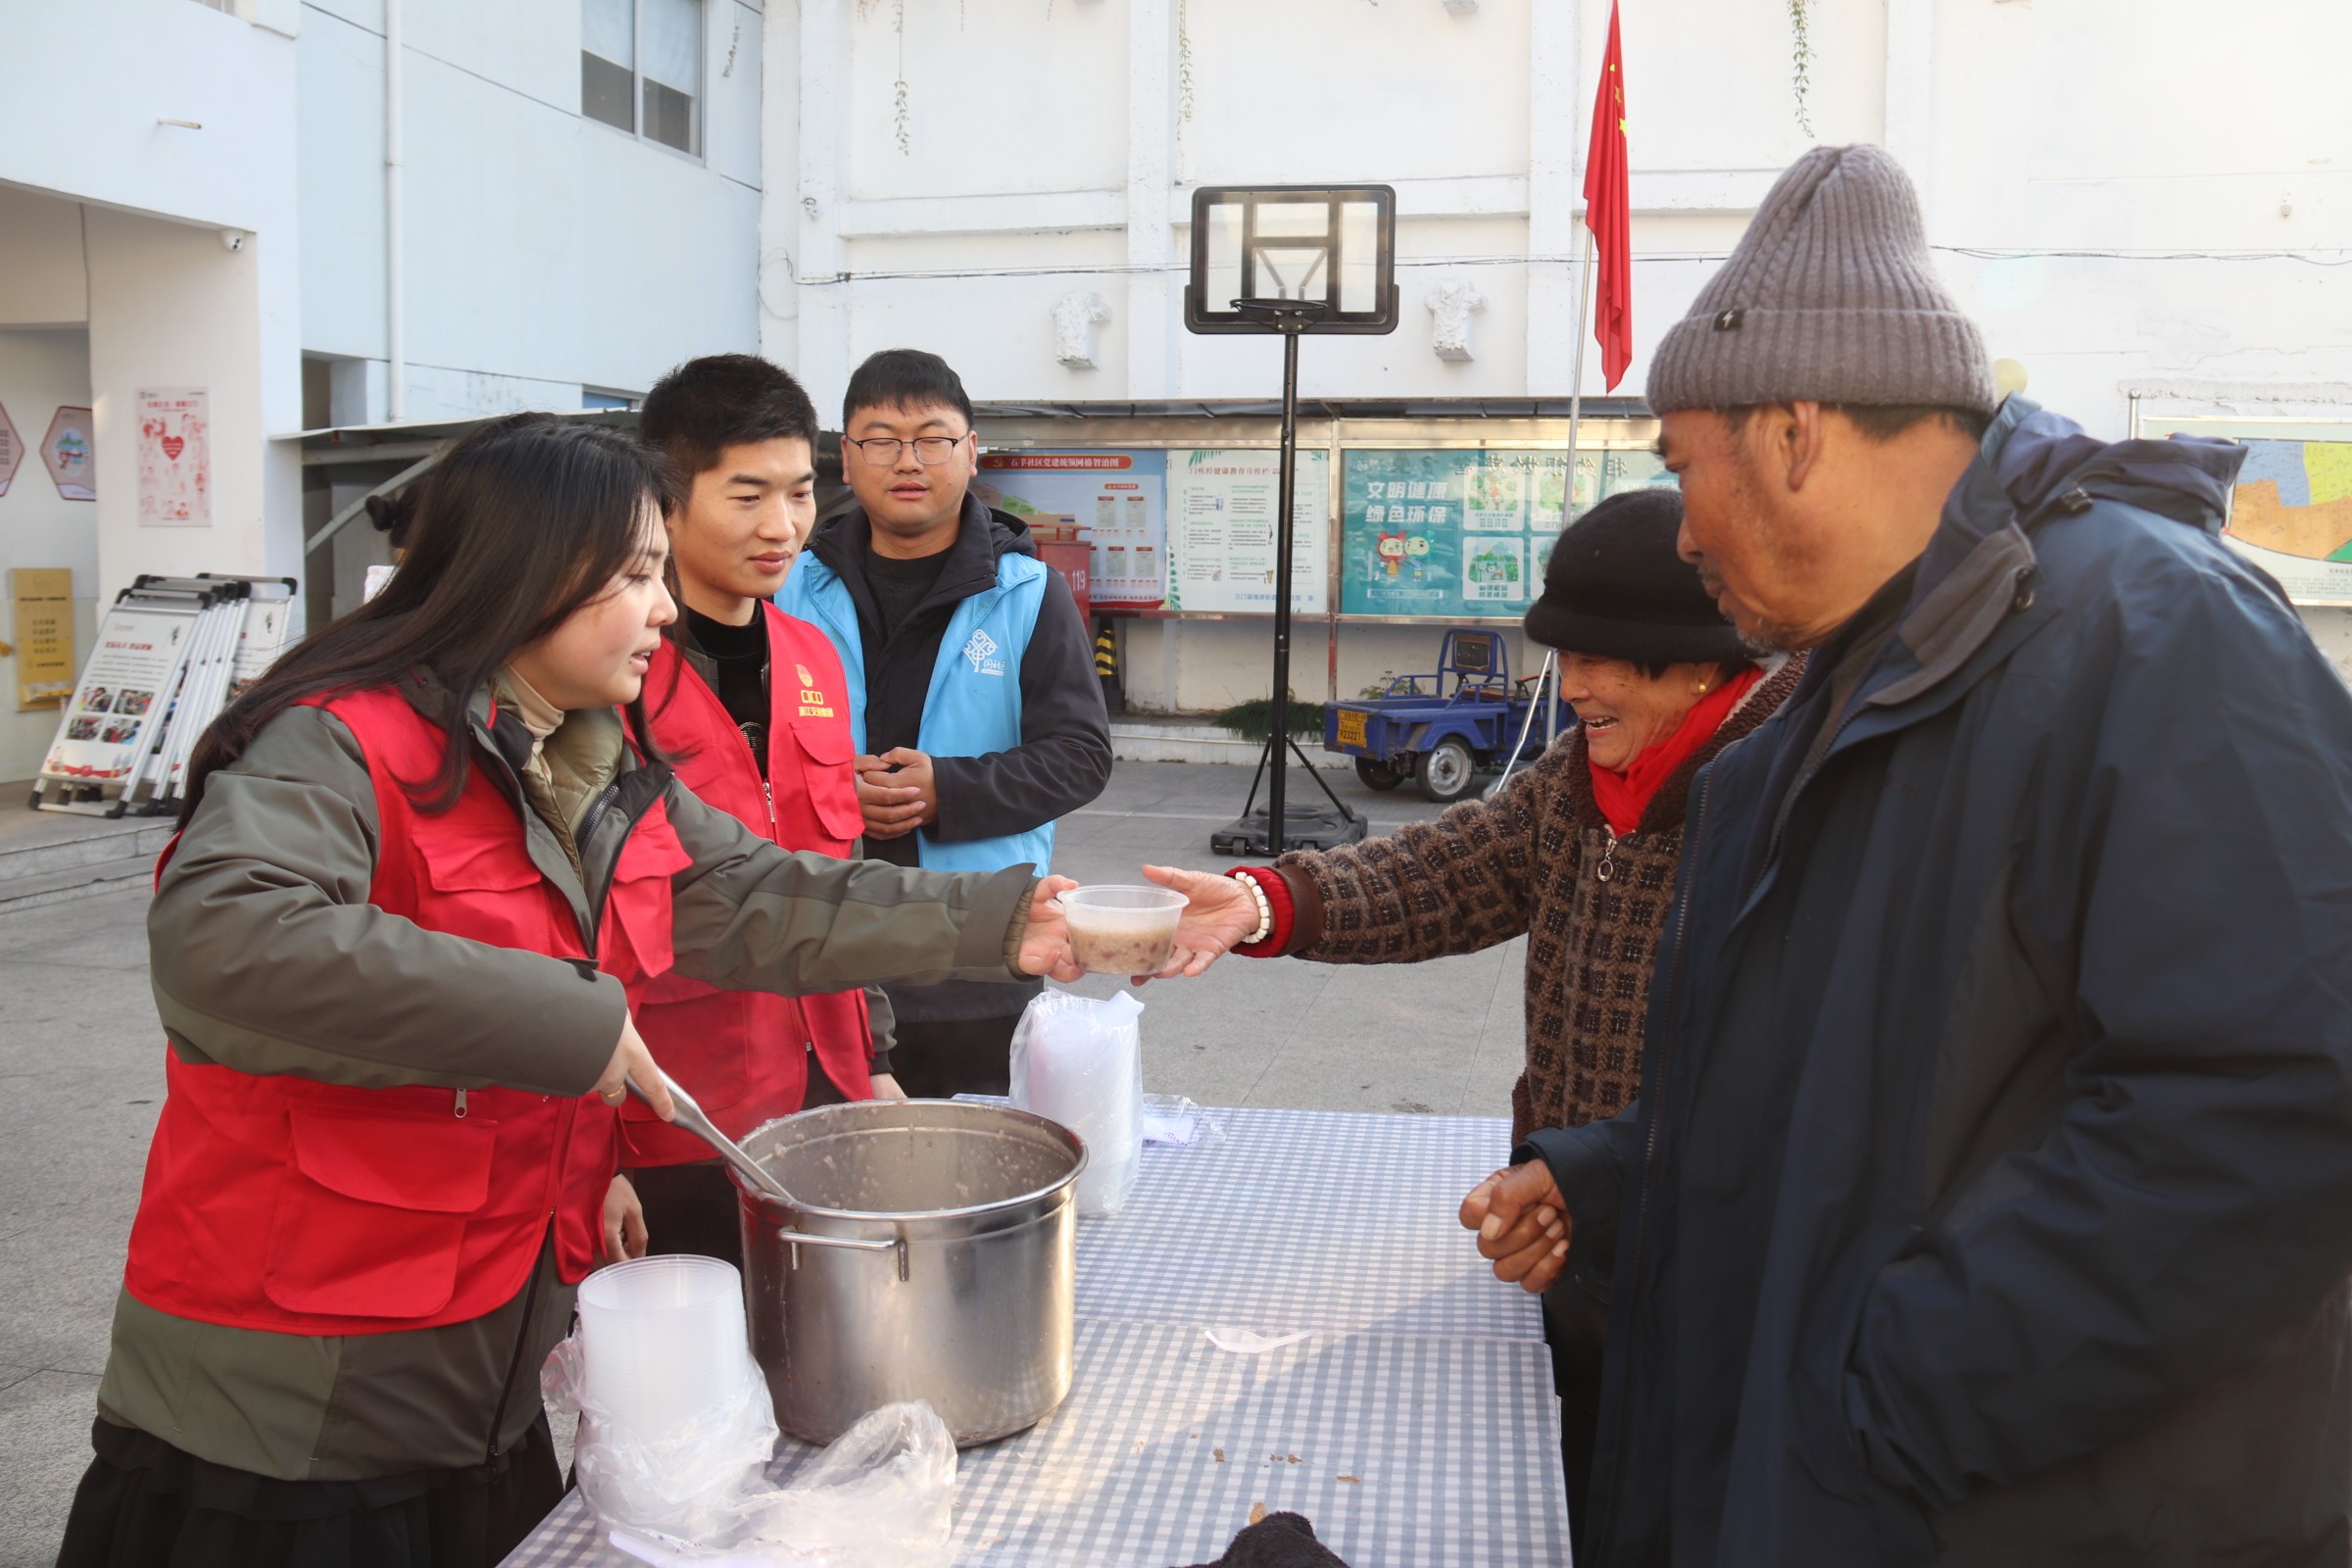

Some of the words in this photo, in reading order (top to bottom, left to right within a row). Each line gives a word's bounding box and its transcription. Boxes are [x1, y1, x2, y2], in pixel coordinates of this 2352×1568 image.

[1365, 480, 1448, 500] 文明健康
[1365, 504, 1447, 524] 绿色环保
[1071, 569, 1086, 592] 119
[800, 689, 824, 706] CICO
